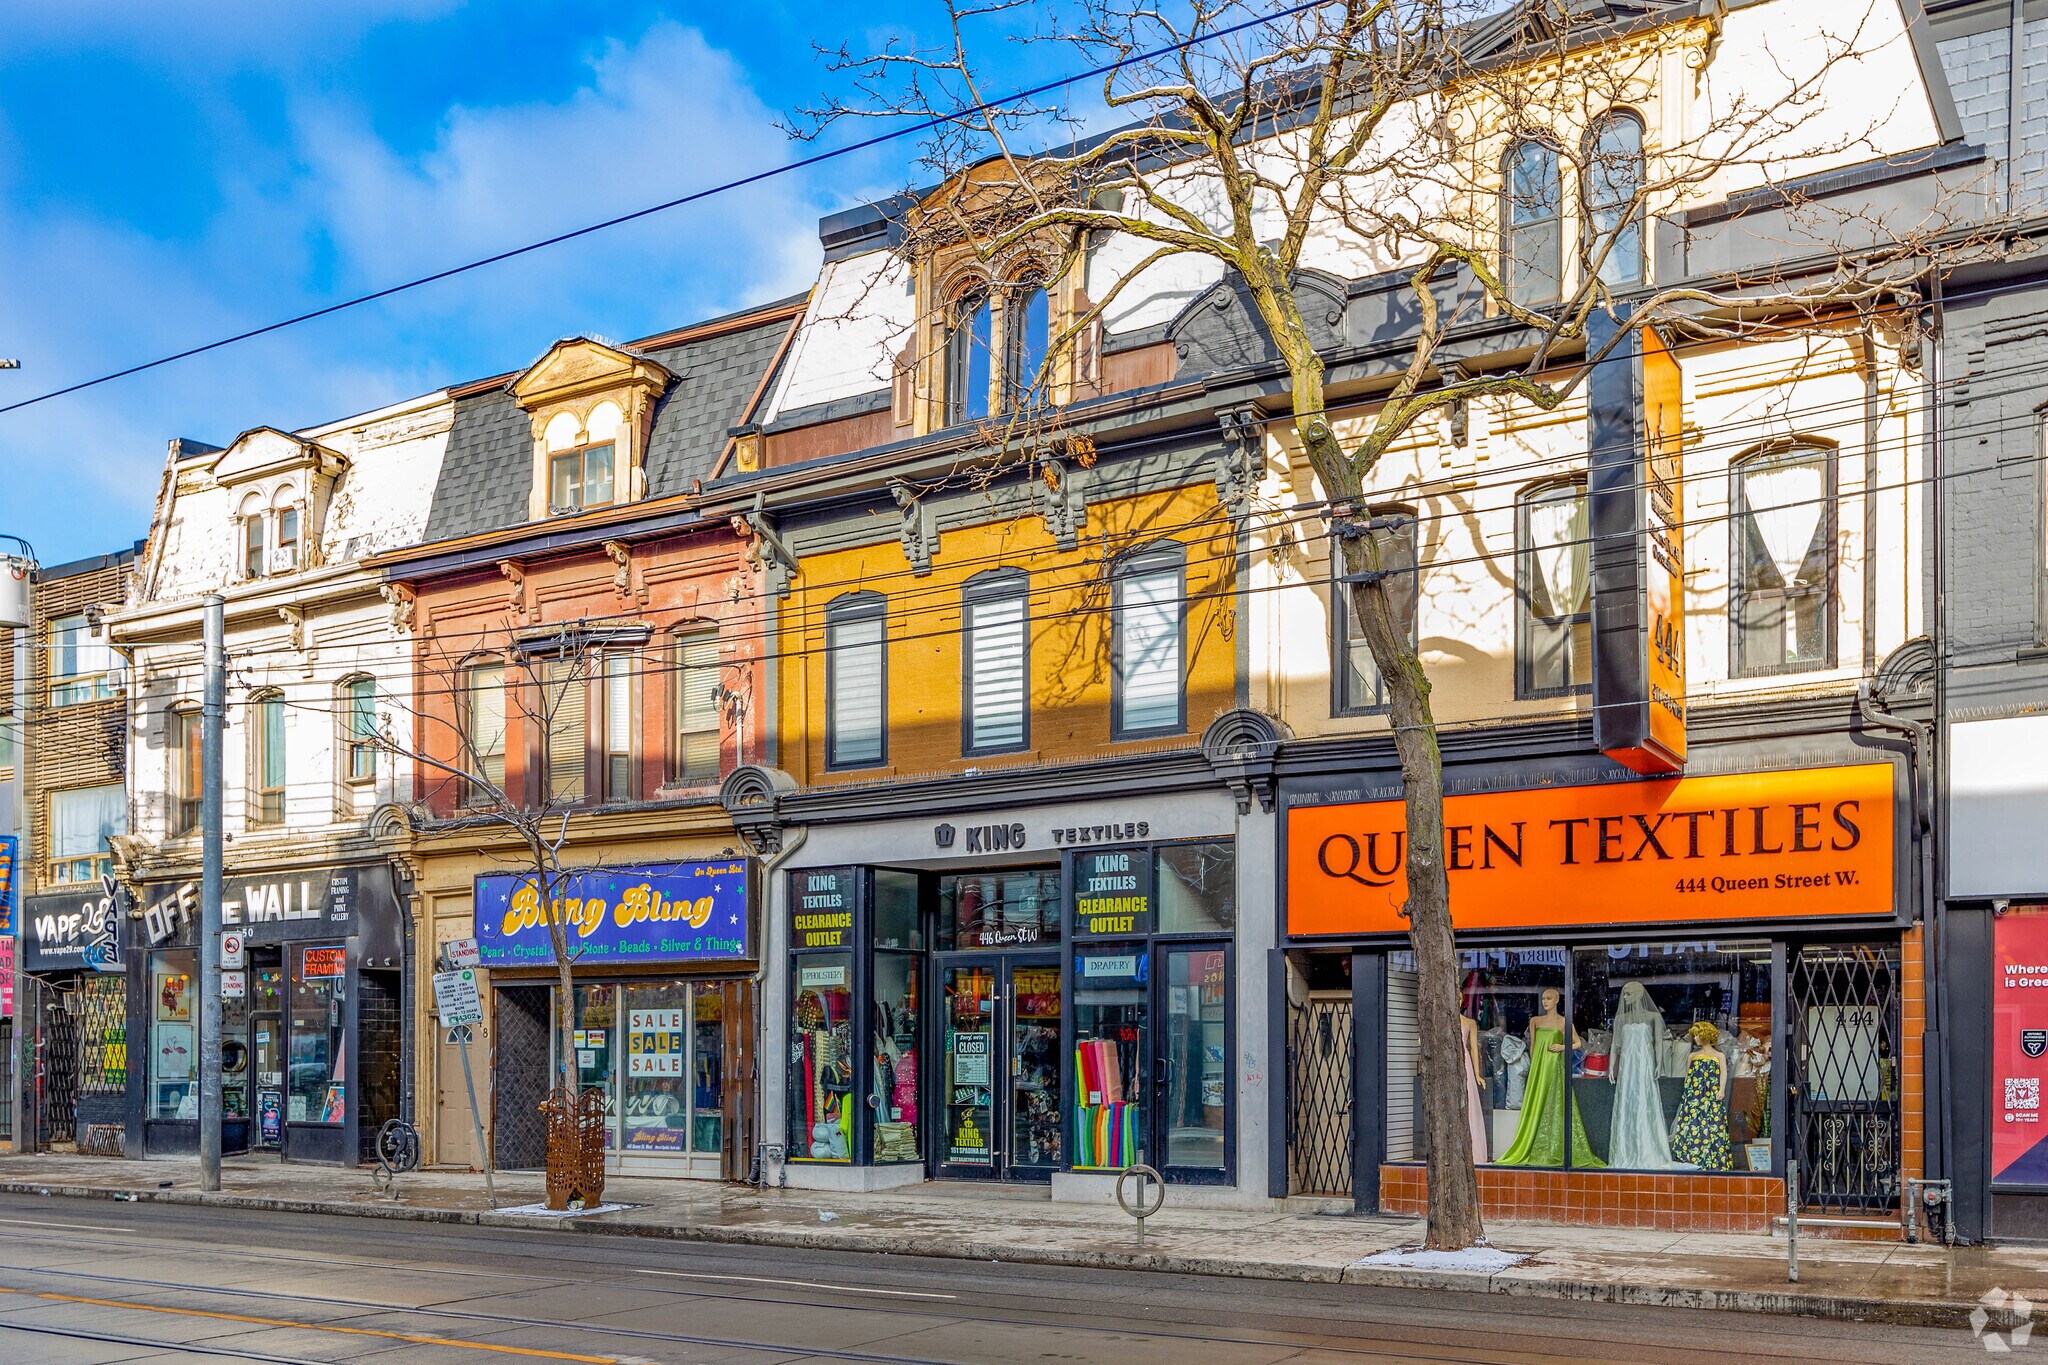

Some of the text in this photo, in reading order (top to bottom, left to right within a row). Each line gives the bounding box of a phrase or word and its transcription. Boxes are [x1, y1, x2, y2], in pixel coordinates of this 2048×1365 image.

[1655, 614, 1680, 678] 444
[966, 821, 1150, 853] KING TEXTILES
[1318, 800, 1861, 887] QUEN TEXTILES
[695, 867, 704, 877] On
[706, 865, 727, 877] Queen
[1095, 854, 1129, 873] KING
[331, 877, 348, 886] CUSTOM
[808, 874, 836, 892] KING
[1088, 875, 1137, 892] TEXTILES
[1675, 870, 1859, 894] 444 Queen Street W.
[330, 886, 349, 895] FRAMING
[245, 881, 321, 922] WALL
[613, 883, 714, 929] Bling
[802, 894, 842, 908] TEXTILES
[1078, 897, 1148, 915] CLEARANCE
[144, 881, 198, 945] OFF
[330, 912, 349, 921] GALLERY
[795, 912, 852, 929] CLEARANCE
[35, 913, 82, 944] VAPE
[1090, 916, 1134, 934] OUTLET
[805, 931, 842, 947] OUTLET
[979, 932, 994, 945] 446
[995, 930, 1017, 943] Queen
[305, 949, 345, 962] CUSTOM
[452, 948, 478, 958] STANDING
[480, 945, 504, 957] Pearl
[513, 944, 547, 959] Crystal
[582, 941, 609, 954] Stone
[618, 939, 650, 953] Beads
[660, 938, 691, 952] Silver
[694, 937, 702, 951] &
[1091, 961, 1130, 970] DRAPERY
[2004, 965, 2048, 975] Where
[2005, 977, 2016, 987] is
[632, 1014, 680, 1028] SALE
[1835, 1011, 1873, 1026] 444
[632, 1036, 680, 1049] SALE
[958, 1041, 985, 1054] CLOSED
[632, 1058, 680, 1072] SALE
[959, 1128, 979, 1139] KING
[955, 1138, 984, 1147] TEXTILES
